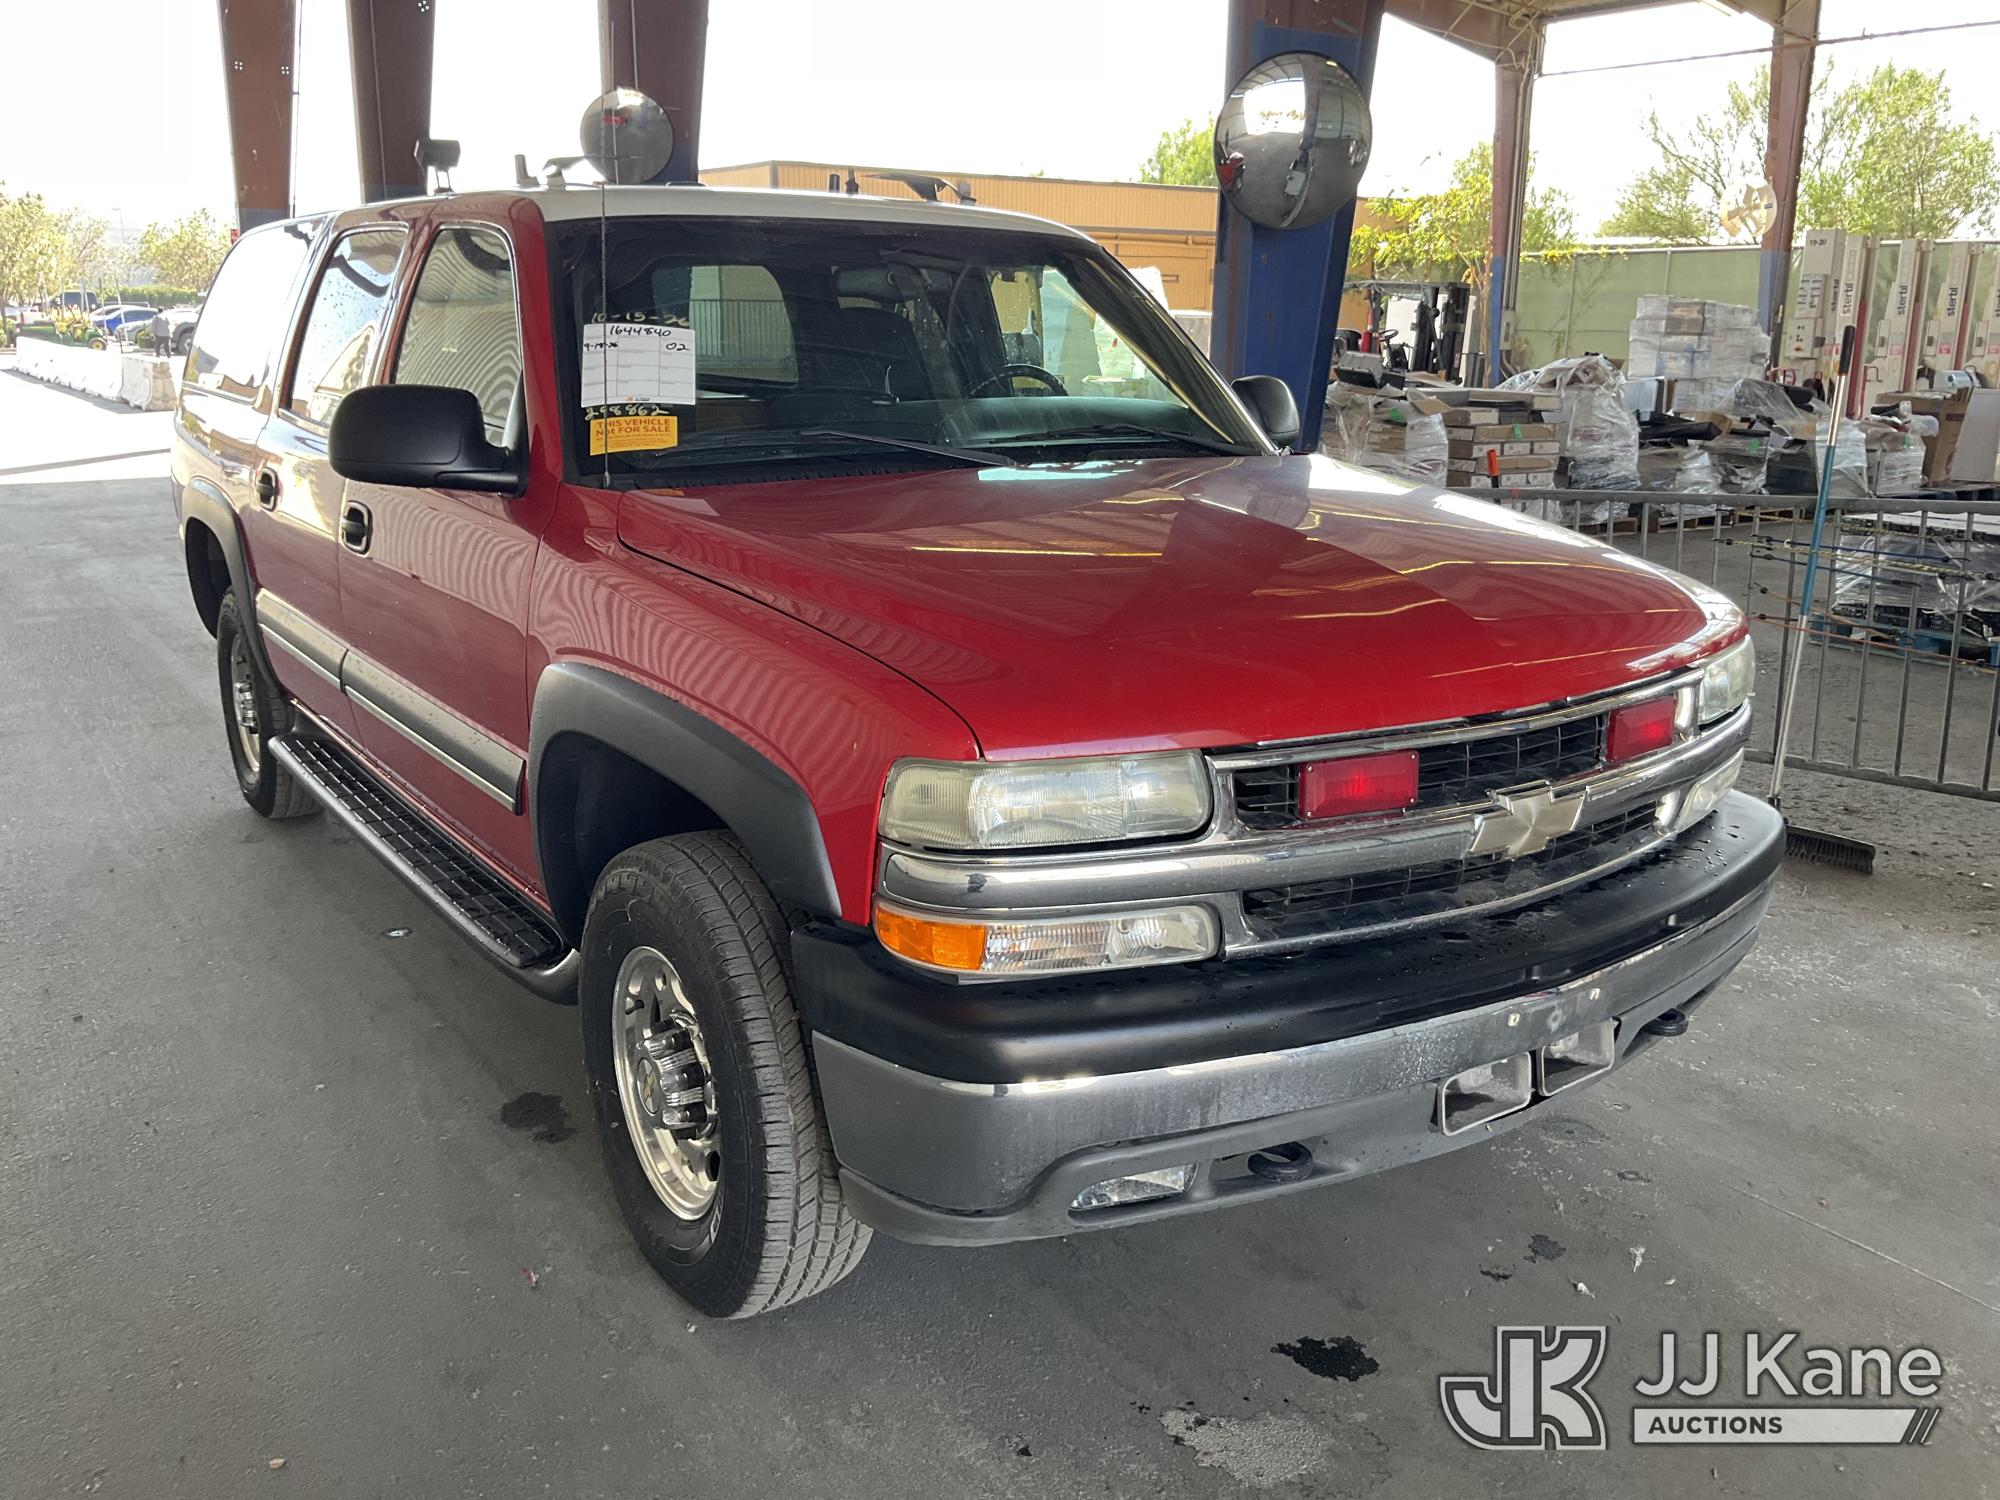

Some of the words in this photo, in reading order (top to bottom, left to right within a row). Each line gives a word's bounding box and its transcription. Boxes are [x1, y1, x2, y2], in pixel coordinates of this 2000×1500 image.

[1896, 285, 1909, 316] stertil
[1947, 287, 1959, 317] stertil
[597, 420, 621, 428] THIS
[624, 418, 671, 426] VEHICLE
[618, 426, 640, 434] FOR
[643, 424, 671, 433] SALE
